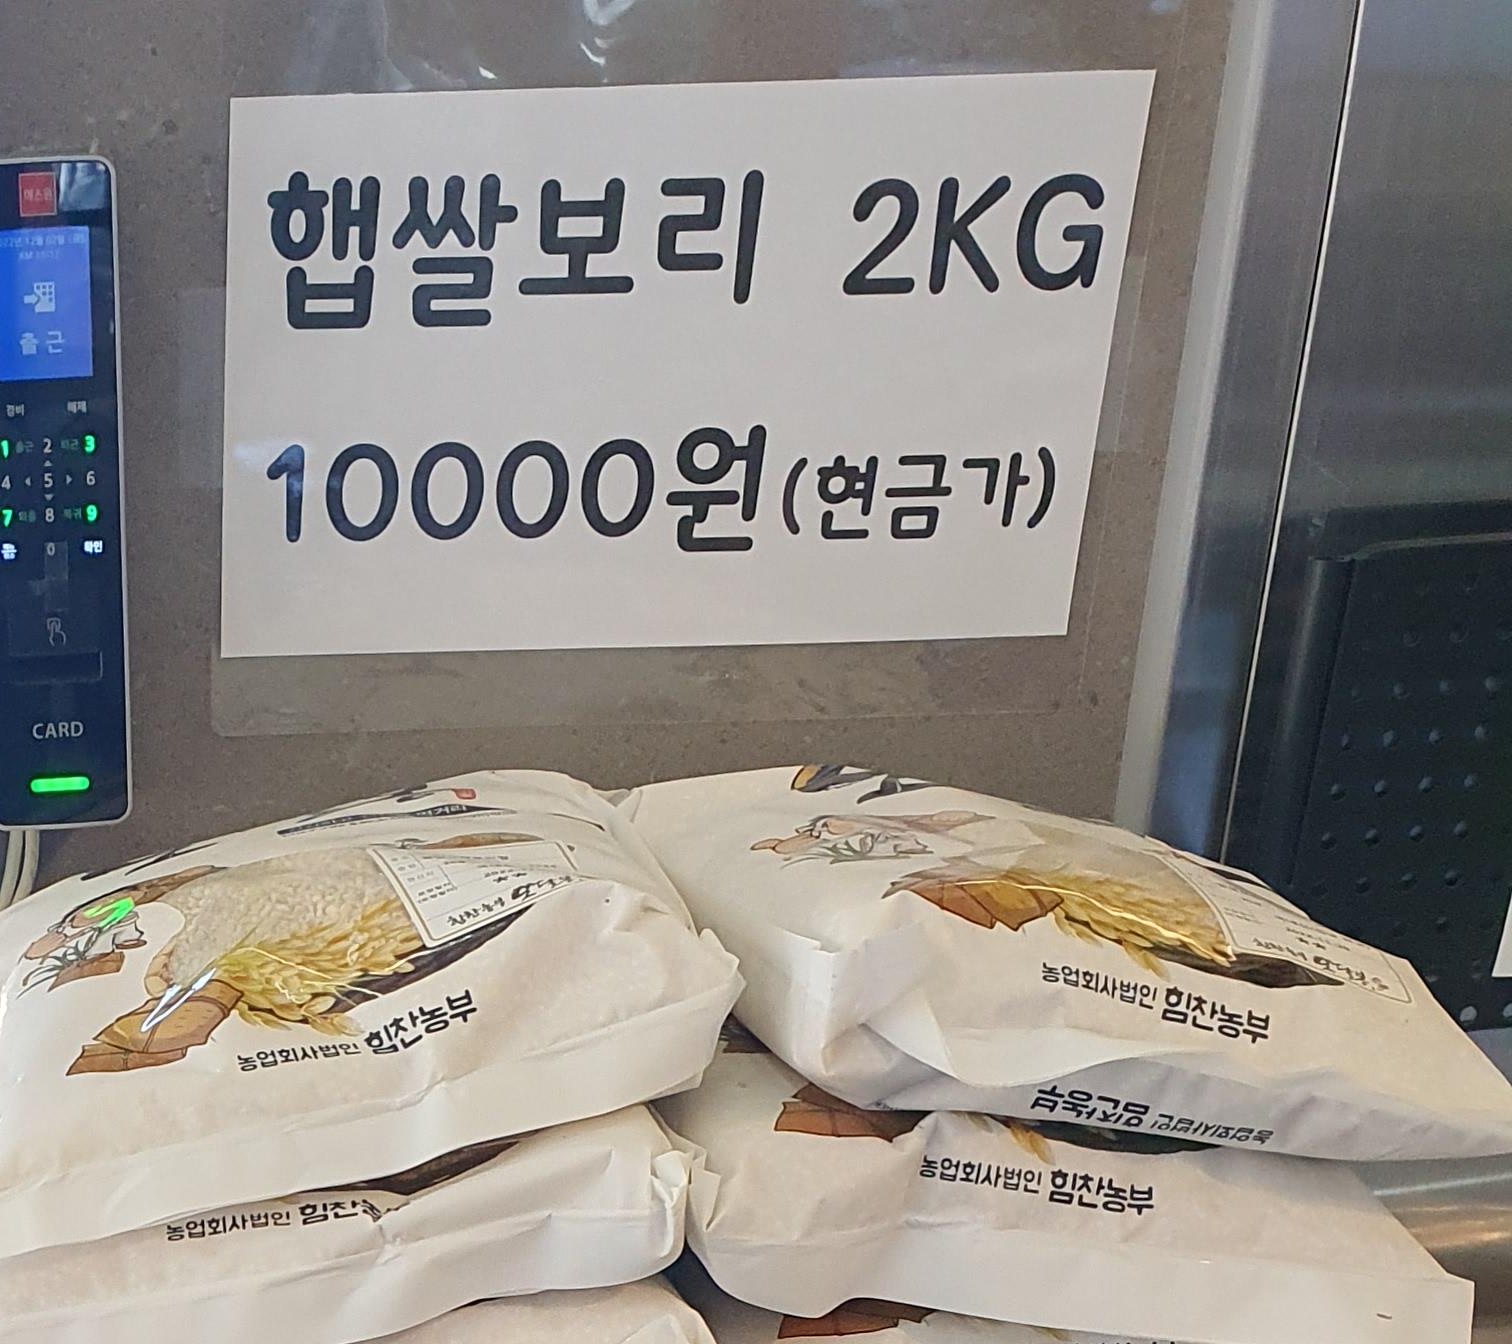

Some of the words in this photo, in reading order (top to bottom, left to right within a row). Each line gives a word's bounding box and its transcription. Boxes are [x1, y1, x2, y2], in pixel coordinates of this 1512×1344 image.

[268, 169, 765, 330] 햅쌀보리
[842, 173, 1104, 295] 2KG
[0, 439, 10, 459] 1
[43, 437, 53, 454] 2
[84, 434, 97, 454] 3
[1, 474, 12, 491] 4
[43, 472, 54, 489] 5
[86, 470, 97, 486] 6
[1, 508, 14, 529] 7
[44, 507, 55, 523] 8
[86, 503, 99, 523] 9
[46, 541, 56, 556] 0
[32, 718, 85, 740] CARD
[1041, 962, 1158, 1010] 농업회사법인
[1160, 986, 1270, 1044] 힘찬농부
[237, 1041, 362, 1072] 농업회사법인
[363, 989, 478, 1055] 힘찬농부
[919, 1154, 1042, 1195] 농업회사법인
[1048, 1168, 1155, 1216] 힘찬농부
[165, 1211, 292, 1242] 농업회사법인
